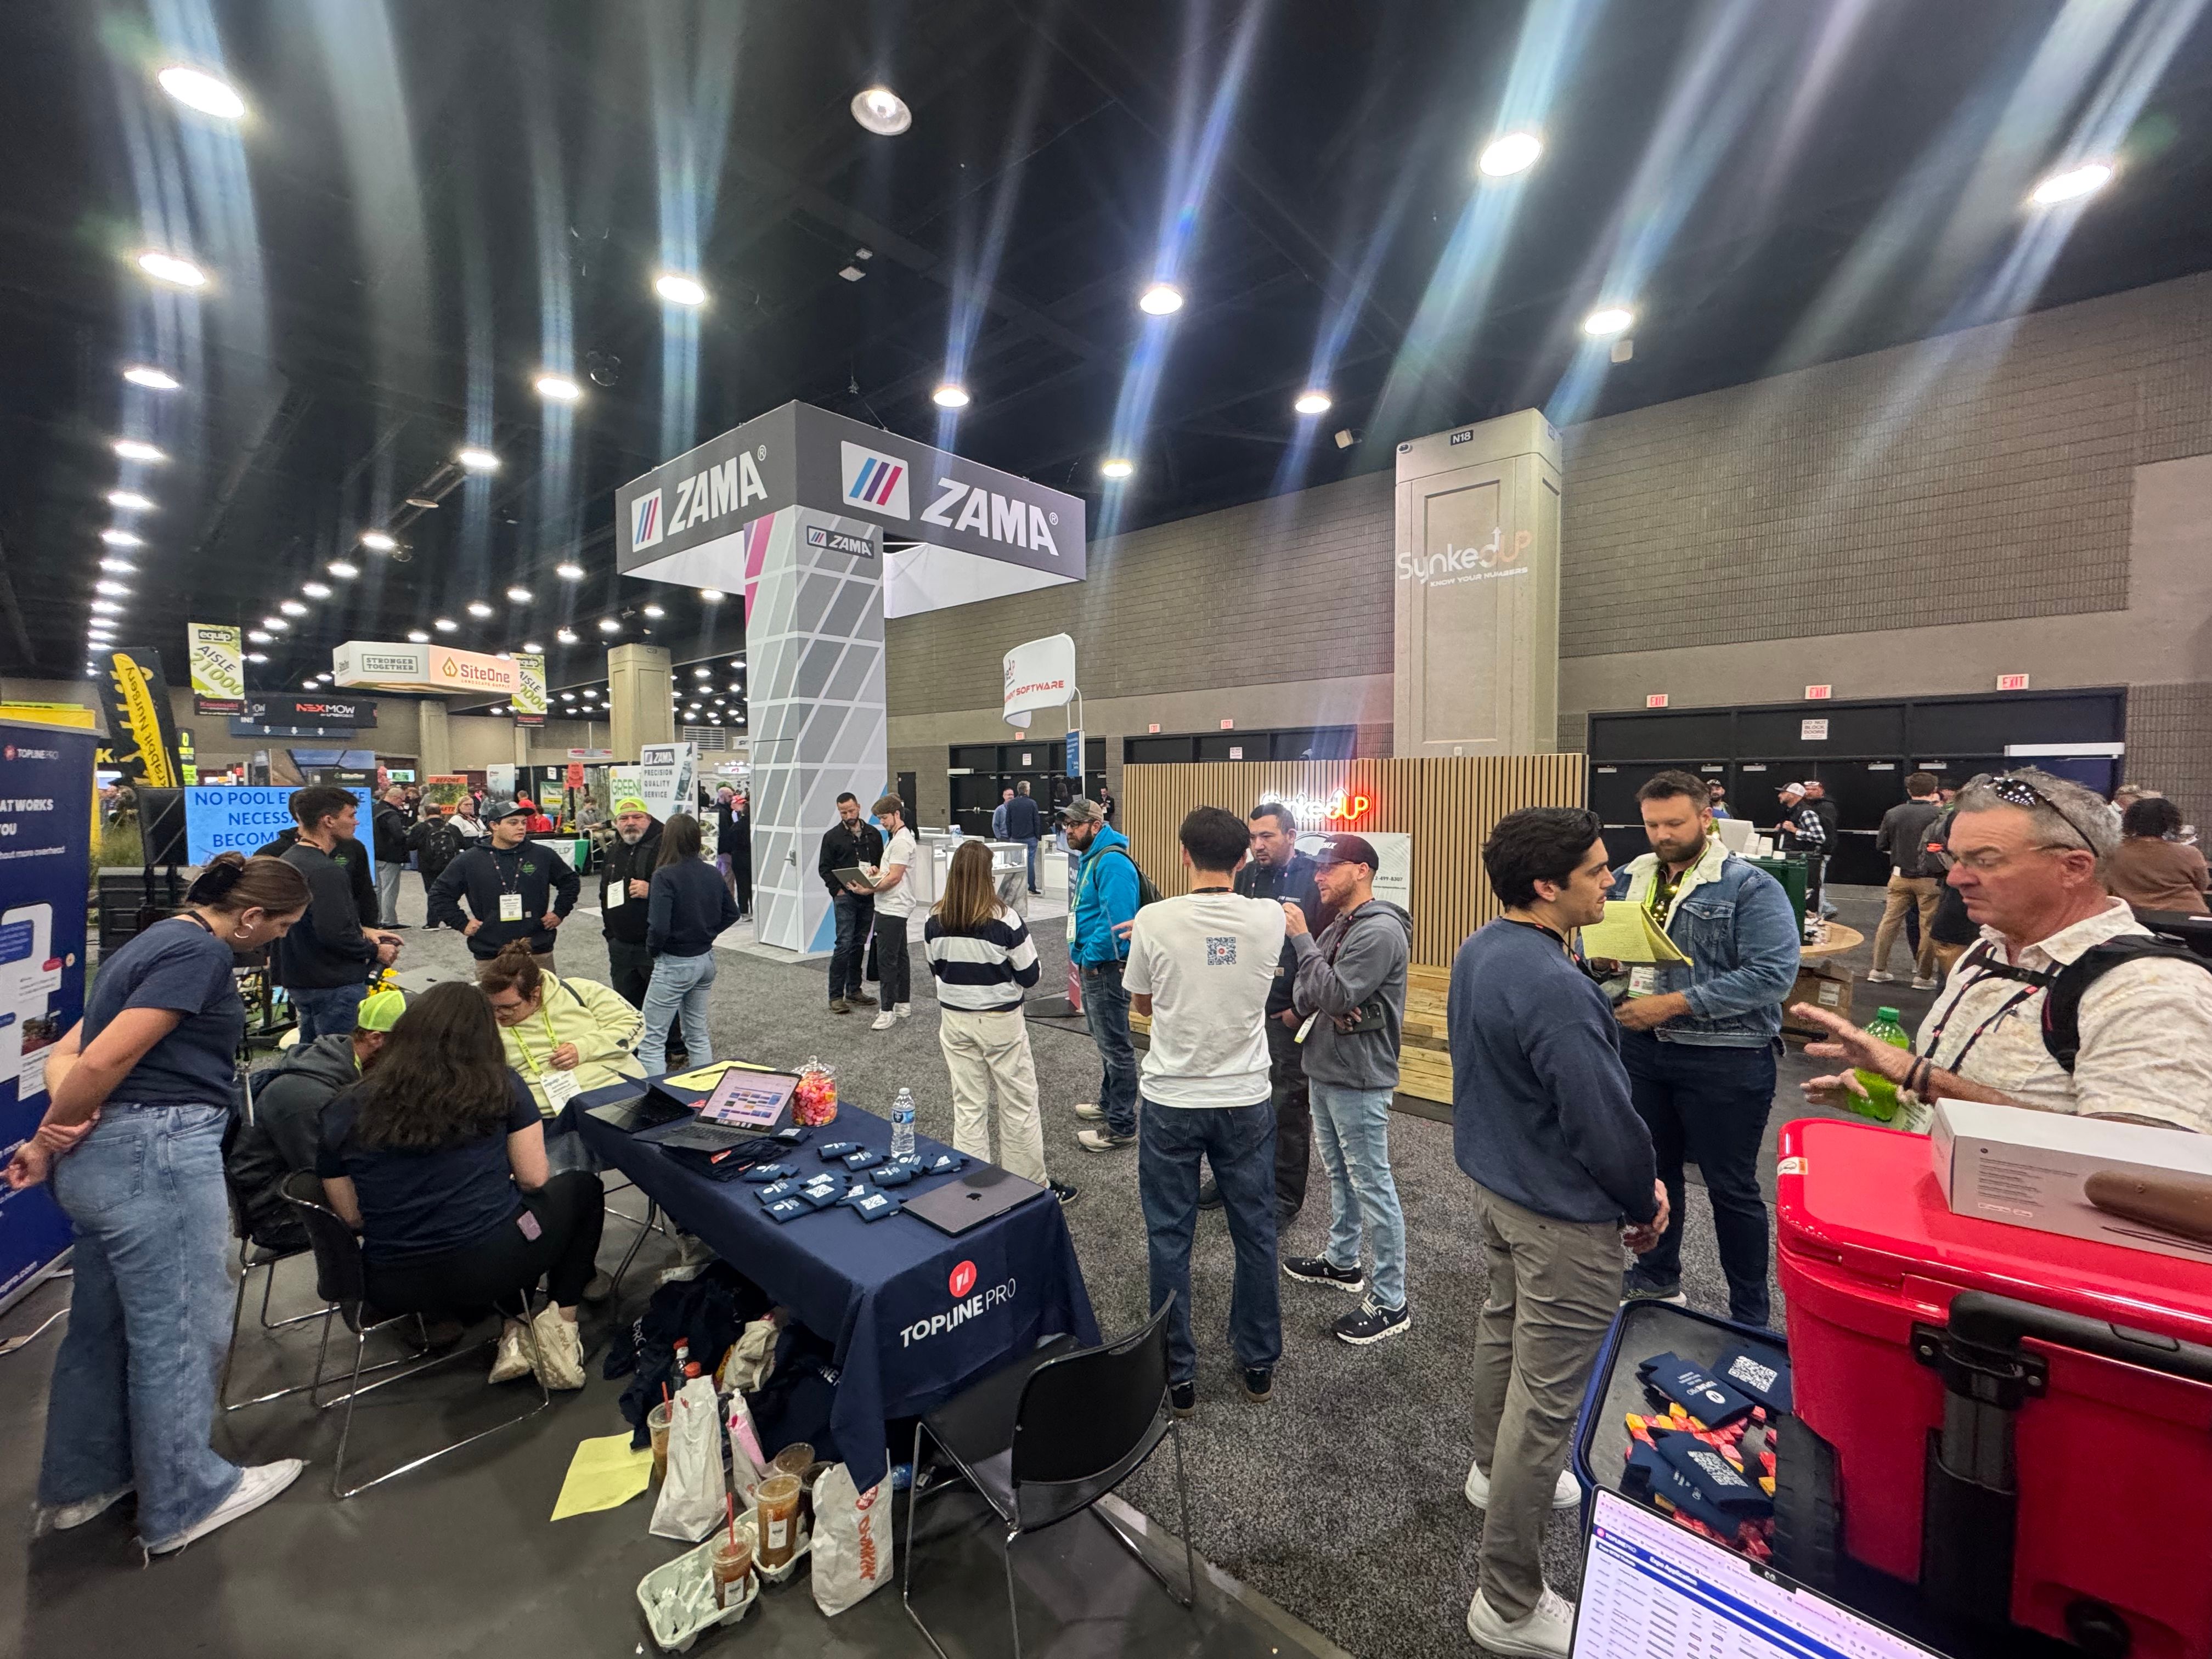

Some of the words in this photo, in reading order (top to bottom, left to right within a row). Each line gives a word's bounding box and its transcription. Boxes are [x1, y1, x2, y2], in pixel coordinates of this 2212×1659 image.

[1452, 432, 1471, 444] N18
[1430, 578, 1455, 587] KNOW
[1457, 574, 1482, 583] YOUR
[1483, 567, 1528, 578] NUMBERS
[199, 631, 231, 641] equip
[198, 646, 236, 673] AISLE
[461, 664, 510, 684] SiteOne
[1016, 680, 1064, 696] SOFTWARE
[2002, 676, 2024, 689] EXIT
[1810, 687, 1828, 698] EXIT
[126, 667, 149, 732] Nursery
[1650, 696, 1665, 706] EXIT
[653, 752, 674, 764] ZAMA
[15, 799, 54, 811] WORKS
[195, 792, 223, 805] NO
[228, 792, 274, 804] POOL
[900, 1295, 983, 1347] TOPLINE
[986, 1278, 1015, 1310] PRO
